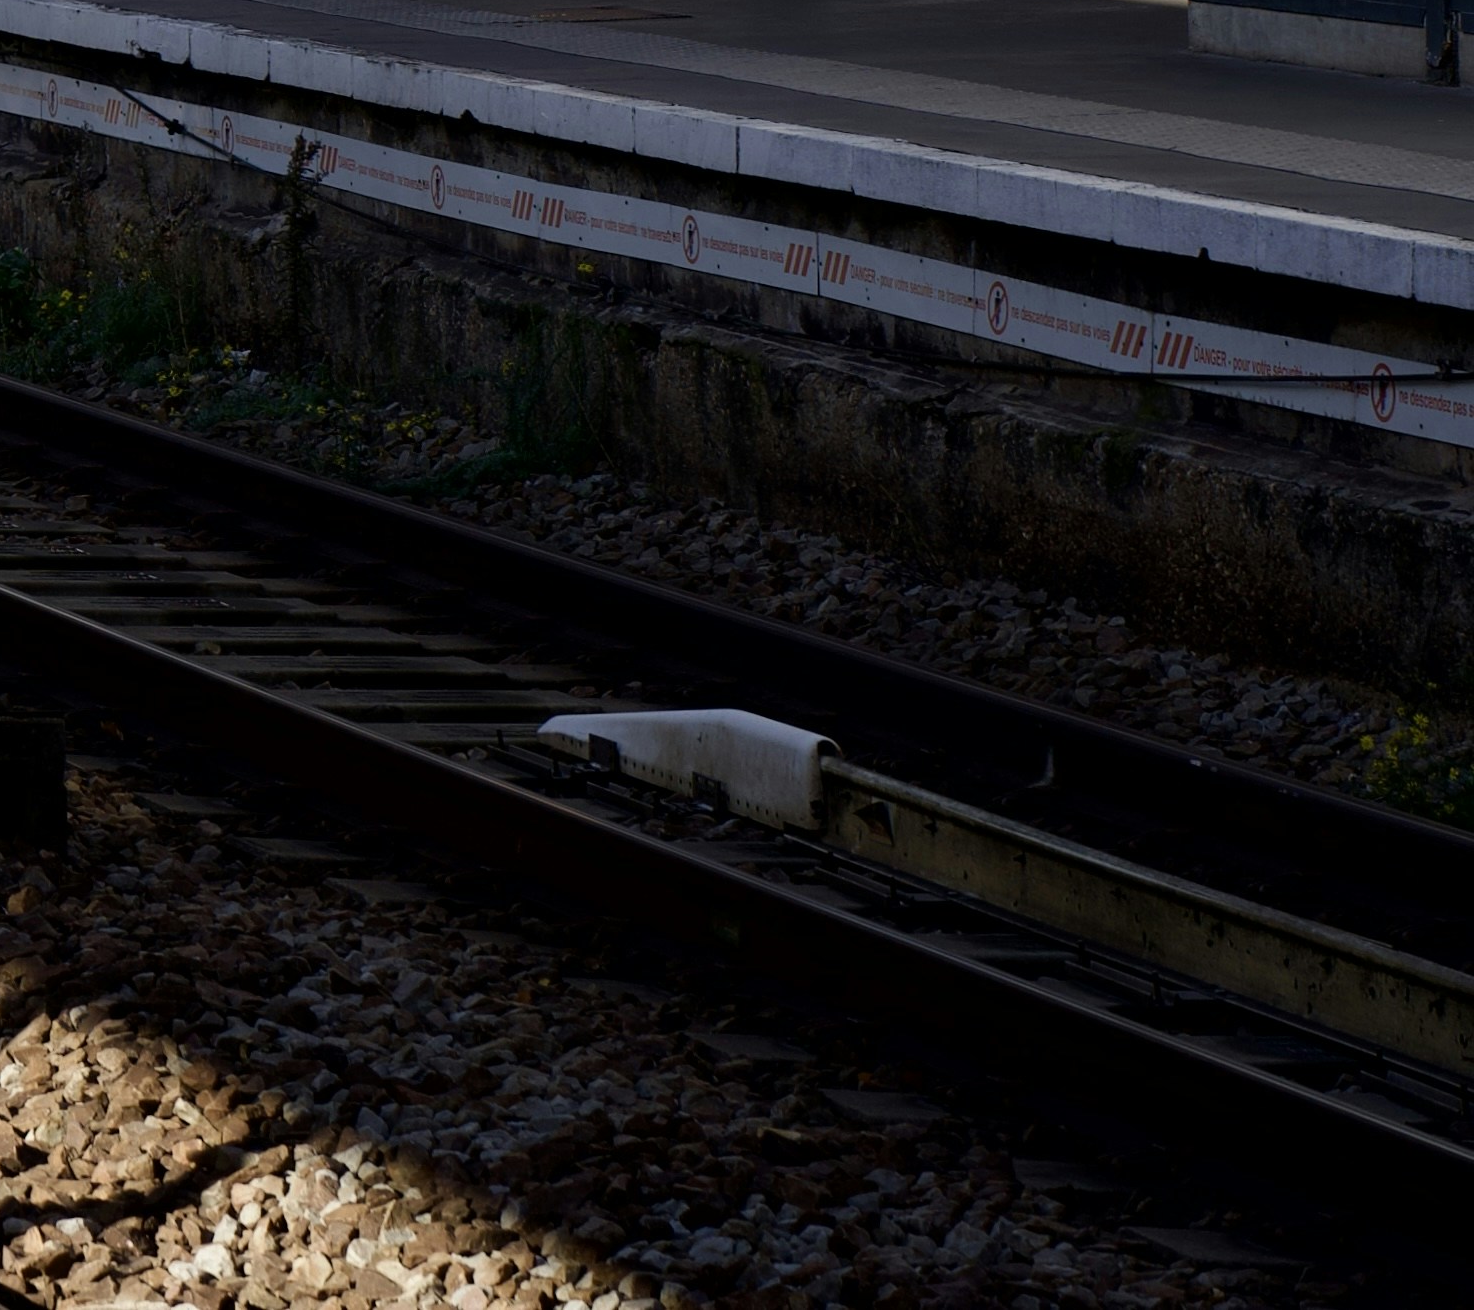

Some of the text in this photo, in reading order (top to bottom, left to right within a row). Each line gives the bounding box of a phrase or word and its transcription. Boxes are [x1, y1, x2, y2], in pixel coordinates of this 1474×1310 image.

[1020, 307, 1055, 329] descendez
[1056, 317, 1068, 332] pas
[1069, 320, 1080, 333] sur
[1081, 322, 1092, 336] les
[1093, 325, 1110, 341] voies
[1194, 344, 1227, 367] DANGER
[1232, 355, 1251, 374] pour
[1251, 358, 1272, 375] votre
[1399, 390, 1409, 401] ne
[1410, 390, 1450, 412] descendez
[1453, 399, 1467, 417] pas
